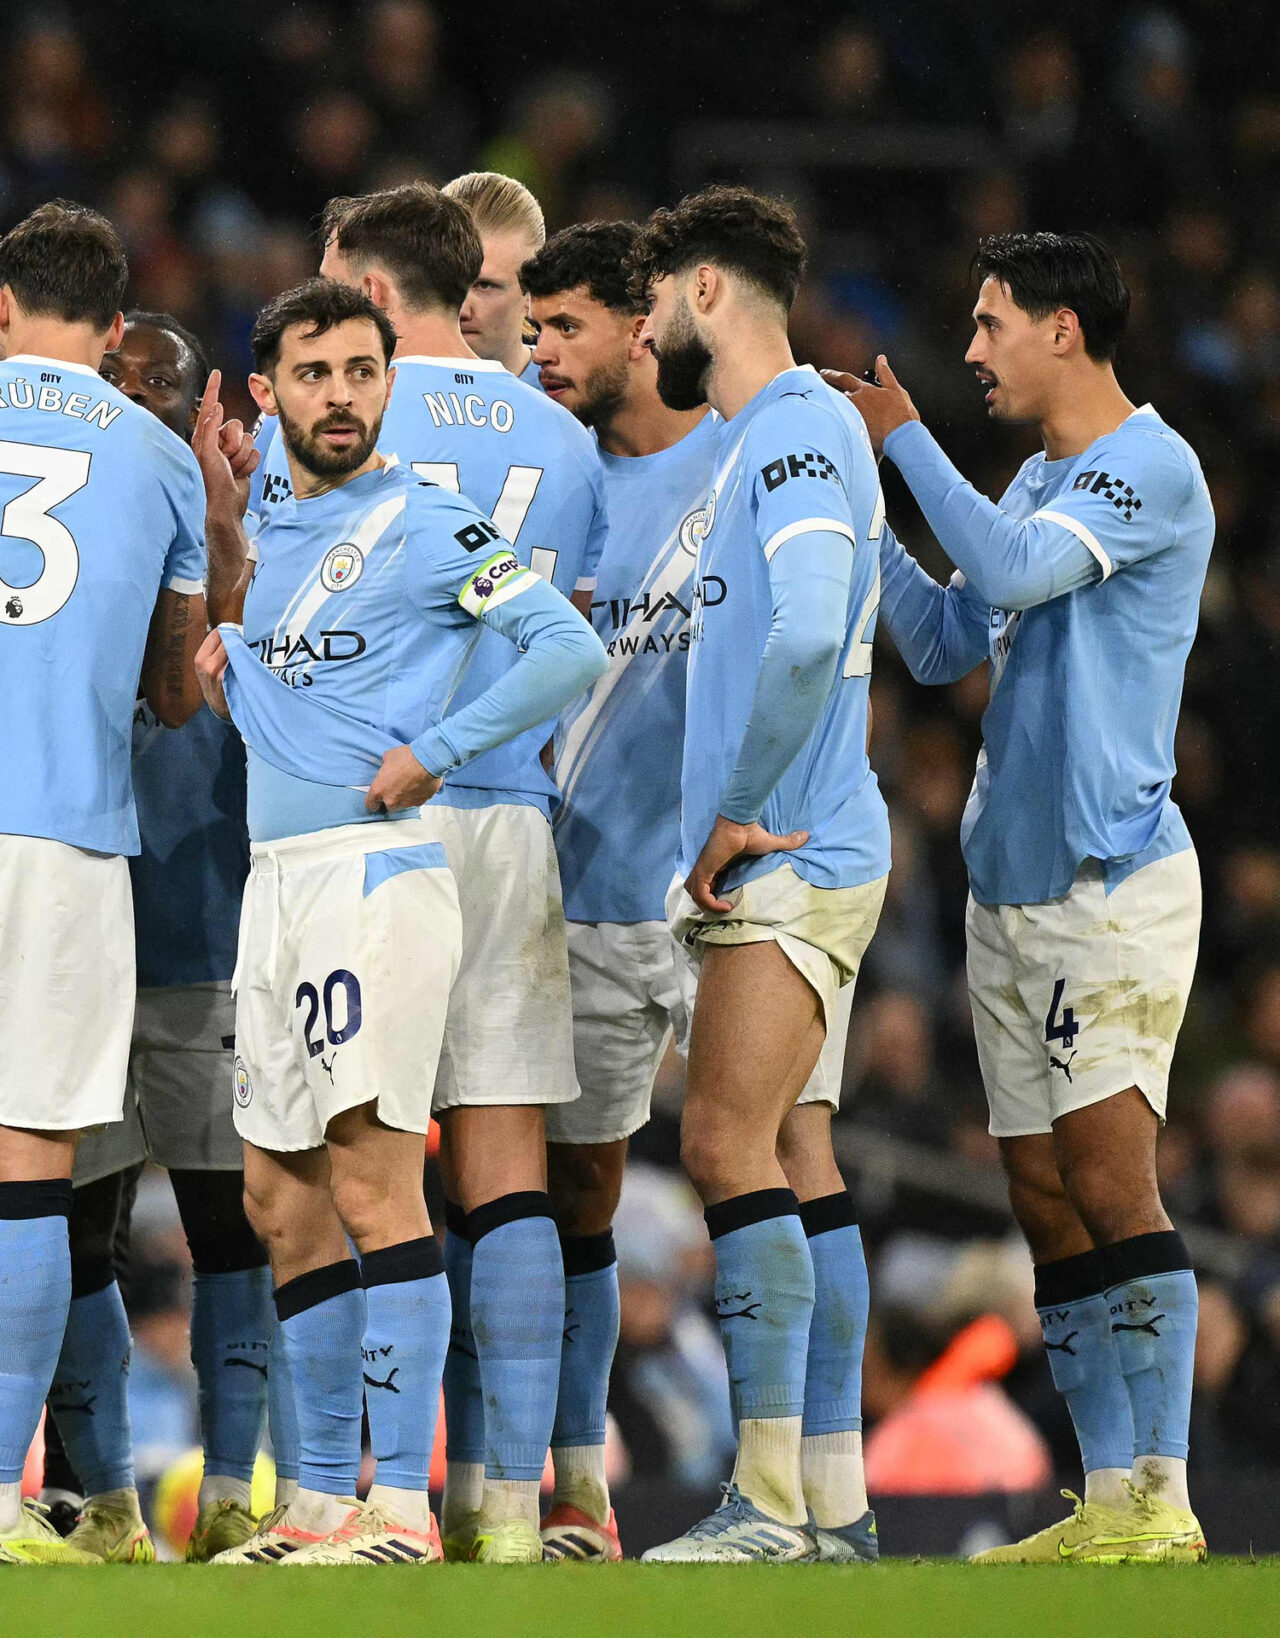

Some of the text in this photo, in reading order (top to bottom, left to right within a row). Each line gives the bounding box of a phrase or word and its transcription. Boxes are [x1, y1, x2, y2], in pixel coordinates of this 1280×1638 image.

[40, 372, 61, 384] CITY
[454, 373, 474, 385] CITY
[423, 392, 515, 433] NICO
[1072, 470, 1142, 522] OKX
[606, 631, 691, 658] RWAYS
[295, 968, 363, 1059] 20
[1044, 978, 1079, 1049] 4
[1040, 1310, 1070, 1327] ITY
